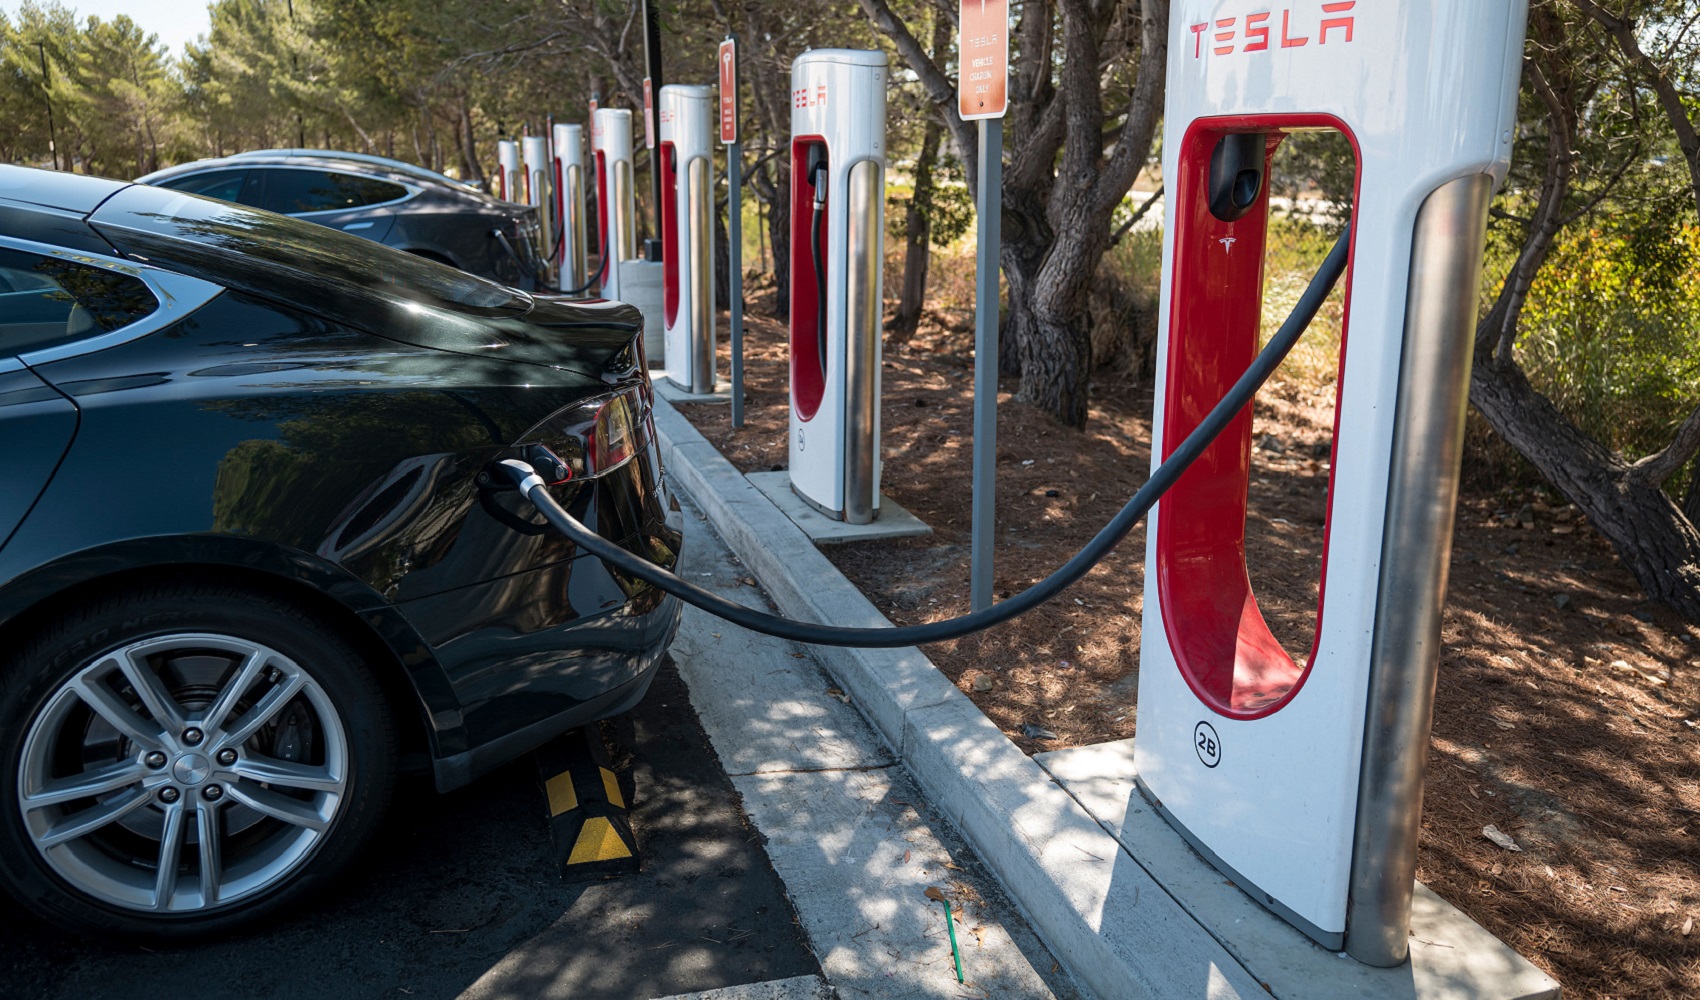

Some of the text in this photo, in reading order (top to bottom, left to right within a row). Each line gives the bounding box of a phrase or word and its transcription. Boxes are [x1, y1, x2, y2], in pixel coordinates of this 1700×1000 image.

[1190, 1, 1356, 59] TESLA
[969, 34, 999, 48] TESLA
[972, 57, 993, 68] VEHICLE
[1198, 732, 1216, 757] 2B
